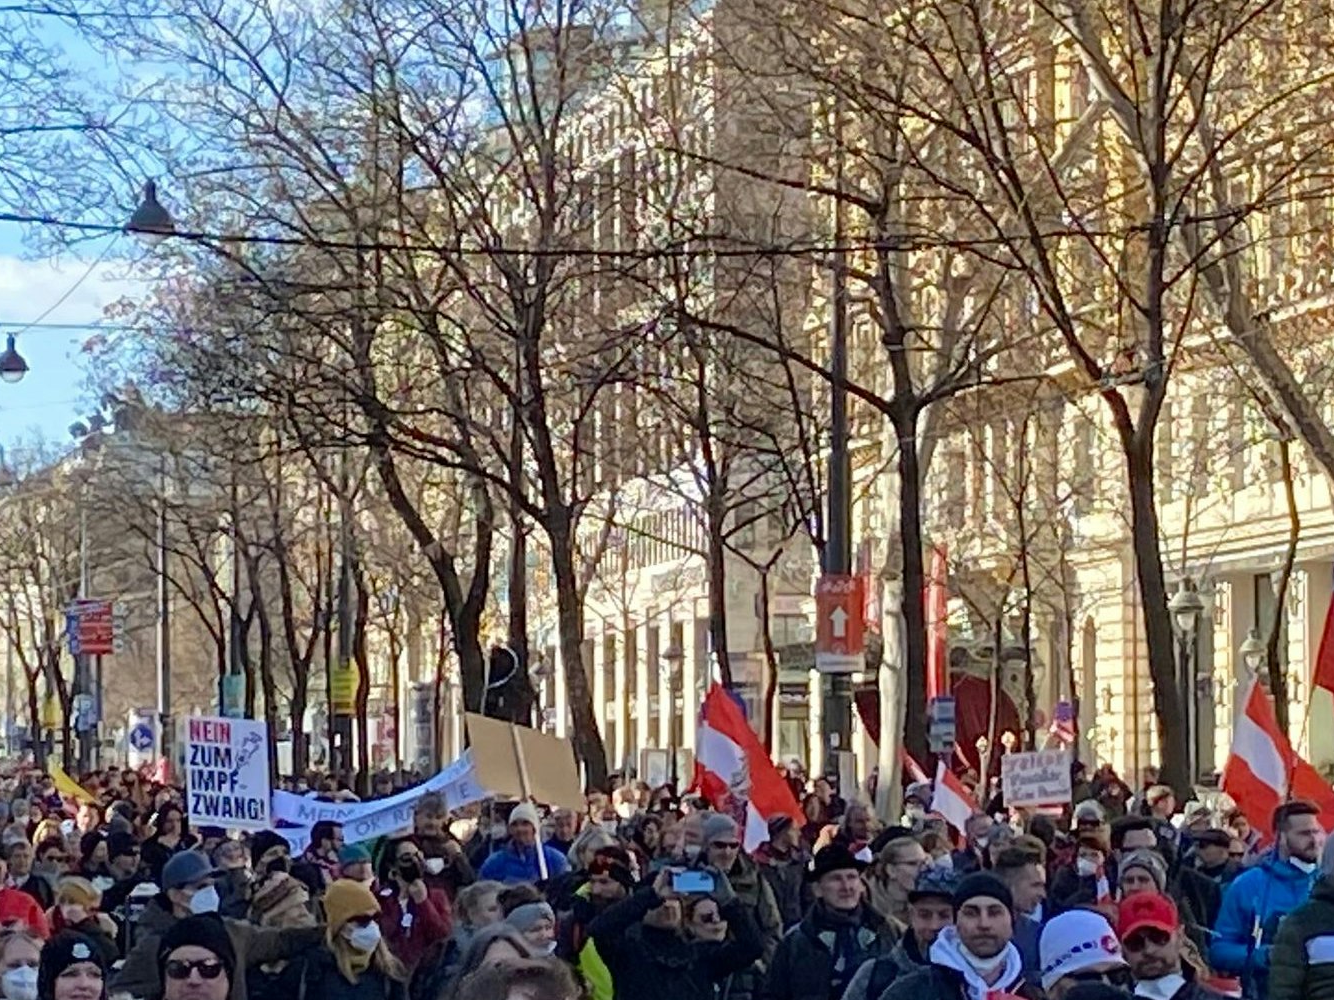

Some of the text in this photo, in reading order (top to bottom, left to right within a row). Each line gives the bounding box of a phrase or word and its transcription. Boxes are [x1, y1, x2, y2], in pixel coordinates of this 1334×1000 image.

[190, 719, 231, 744] NEIN
[190, 744, 233, 769] ZUM
[191, 769, 248, 794] IMPF-
[192, 793, 265, 821] ZWANG!
